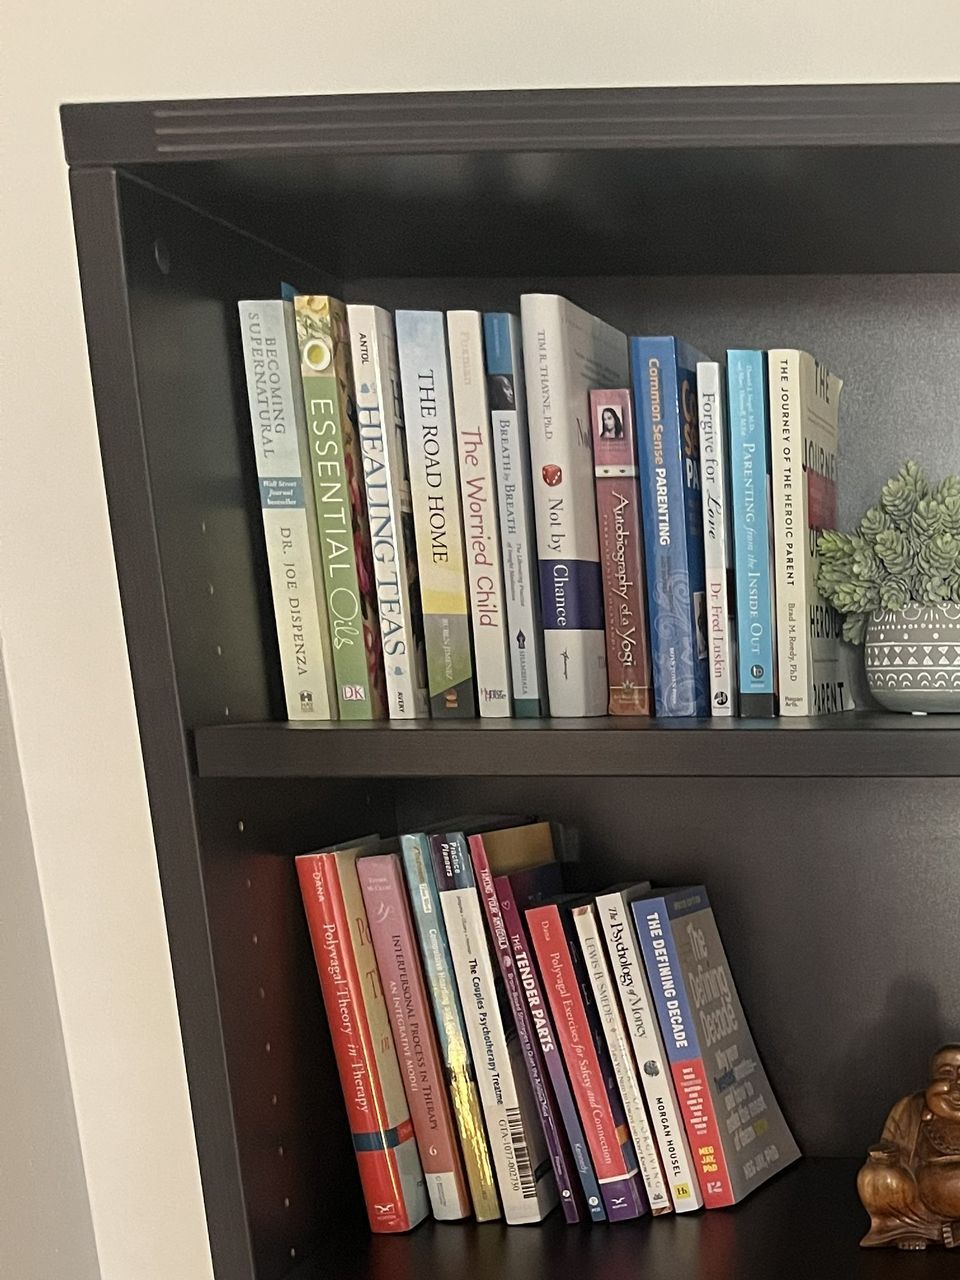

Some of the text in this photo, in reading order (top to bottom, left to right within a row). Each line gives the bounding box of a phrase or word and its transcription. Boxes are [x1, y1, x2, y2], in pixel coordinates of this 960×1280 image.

[248, 312, 275, 459] SUPERNATURAL
[265, 337, 286, 434] BECOMING
[700, 392, 718, 483] Forgive for
[311, 399, 350, 578] ESSENTIAL
[418, 369, 448, 564] THE ROAD HOME
[648, 358, 670, 546] Common Sense PARENTING
[780, 359, 795, 586] THE JOURNEY OF THE HEROIC PARENT
[357, 405, 406, 656] HEALING TEAS
[461, 426, 498, 628] The Worried Child
[548, 497, 565, 553] Not by
[611, 490, 633, 600] Autobiography
[283, 562, 307, 676] JOE DISPENZA
[553, 564, 569, 626] Chance
[342, 686, 366, 700] DK
[440, 842, 454, 877] Planners
[323, 923, 354, 1035] Polyvagal Theory
[510, 933, 523, 951] THE
[515, 951, 541, 1008] TENDER
[609, 922, 636, 990] Psychology
[628, 998, 650, 1040] Money
[645, 911, 689, 1049] THE DEFINING DECADE
[391, 935, 439, 1131] INTERPERSONAL PROCESS IN THERAPY
[467, 957, 498, 1073] The Couples Psychotherapy
[531, 1007, 554, 1053] PARTS
[549, 951, 614, 1166] Polyvagal Exercises for Safety Connection
[574, 1142, 589, 1175] Kennedy
[655, 1096, 681, 1178] MORGAN HOUSEL
